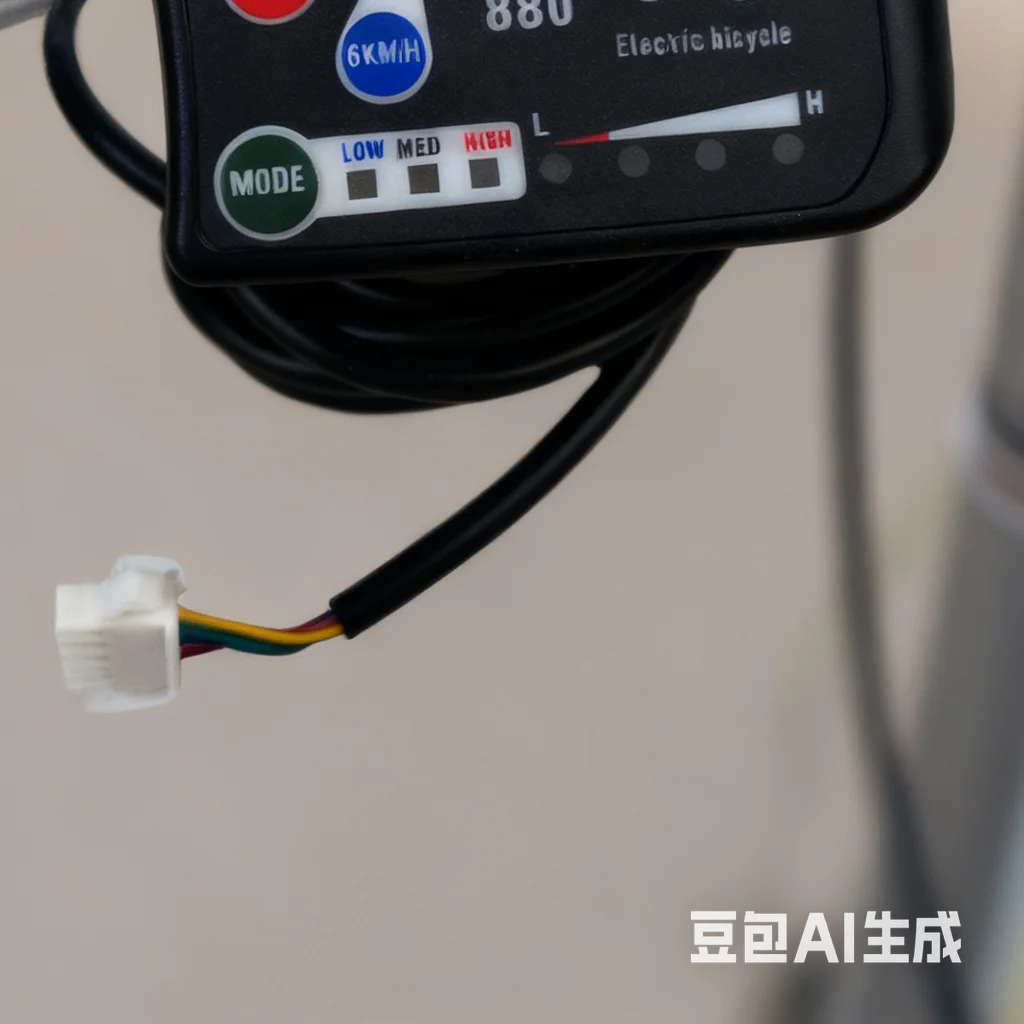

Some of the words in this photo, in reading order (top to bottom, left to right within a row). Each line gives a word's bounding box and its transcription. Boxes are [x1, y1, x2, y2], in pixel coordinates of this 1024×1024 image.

[347, 37, 421, 68] 6KM/H
[615, 28, 705, 58] Electric
[710, 20, 793, 55] bicycle
[805, 89, 824, 115] H
[532, 112, 551, 137] L
[341, 138, 385, 163] LOW
[397, 136, 441, 160] MED
[229, 164, 306, 197] MODE
